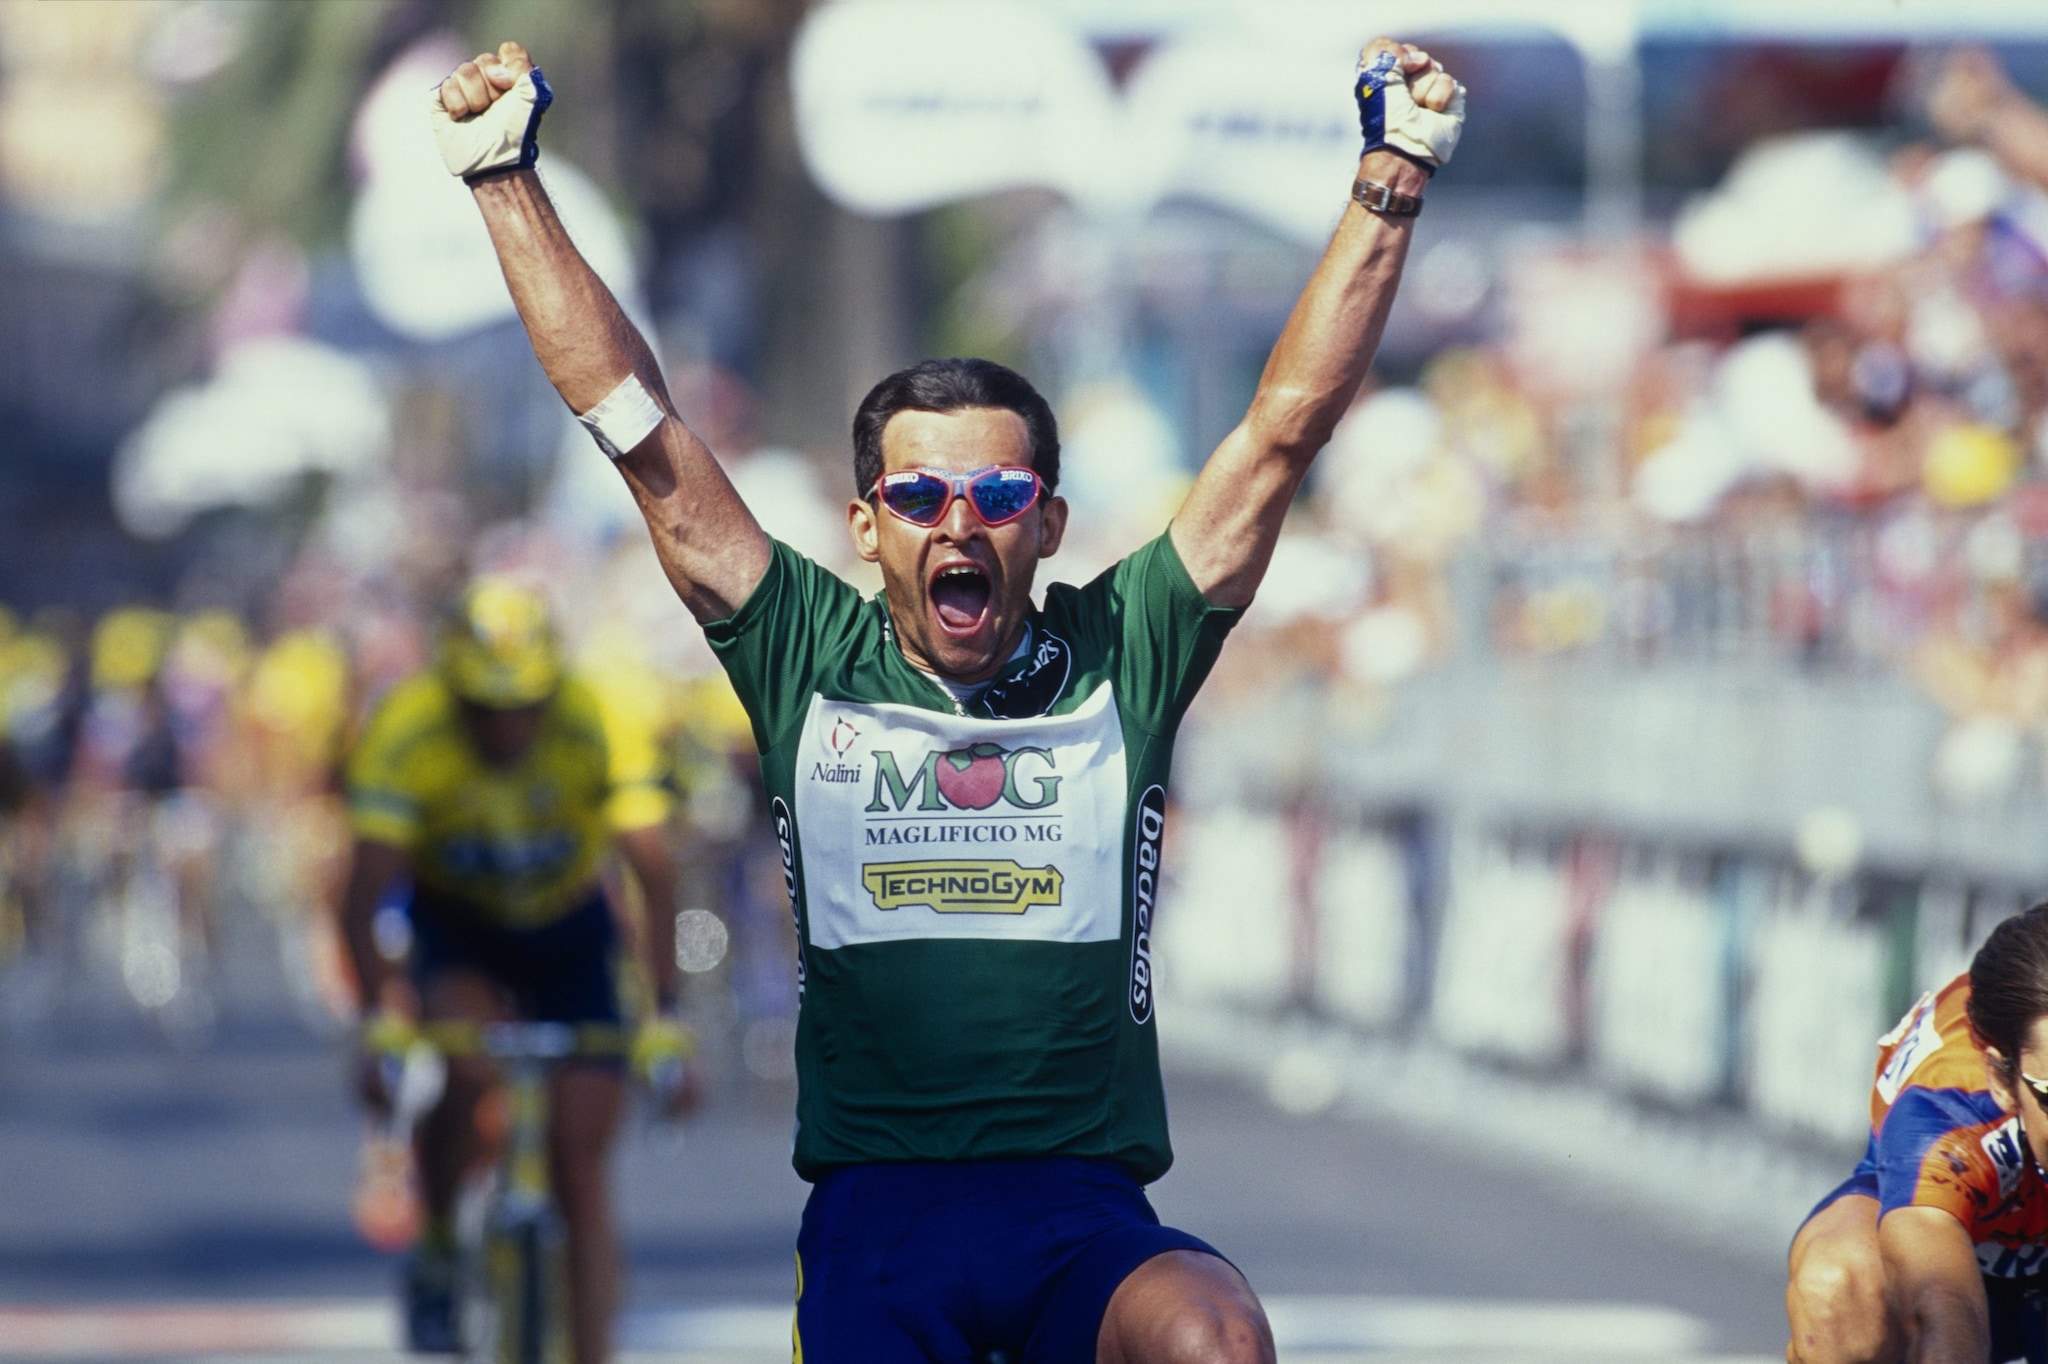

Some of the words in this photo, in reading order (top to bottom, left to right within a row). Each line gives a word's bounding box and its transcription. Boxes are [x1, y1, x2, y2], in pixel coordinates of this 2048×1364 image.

[1000, 470, 1033, 482] BRIKO
[811, 762, 862, 783] Nalini
[864, 826, 1018, 845] MAGLIFICIO
[1025, 824, 1063, 843] MG
